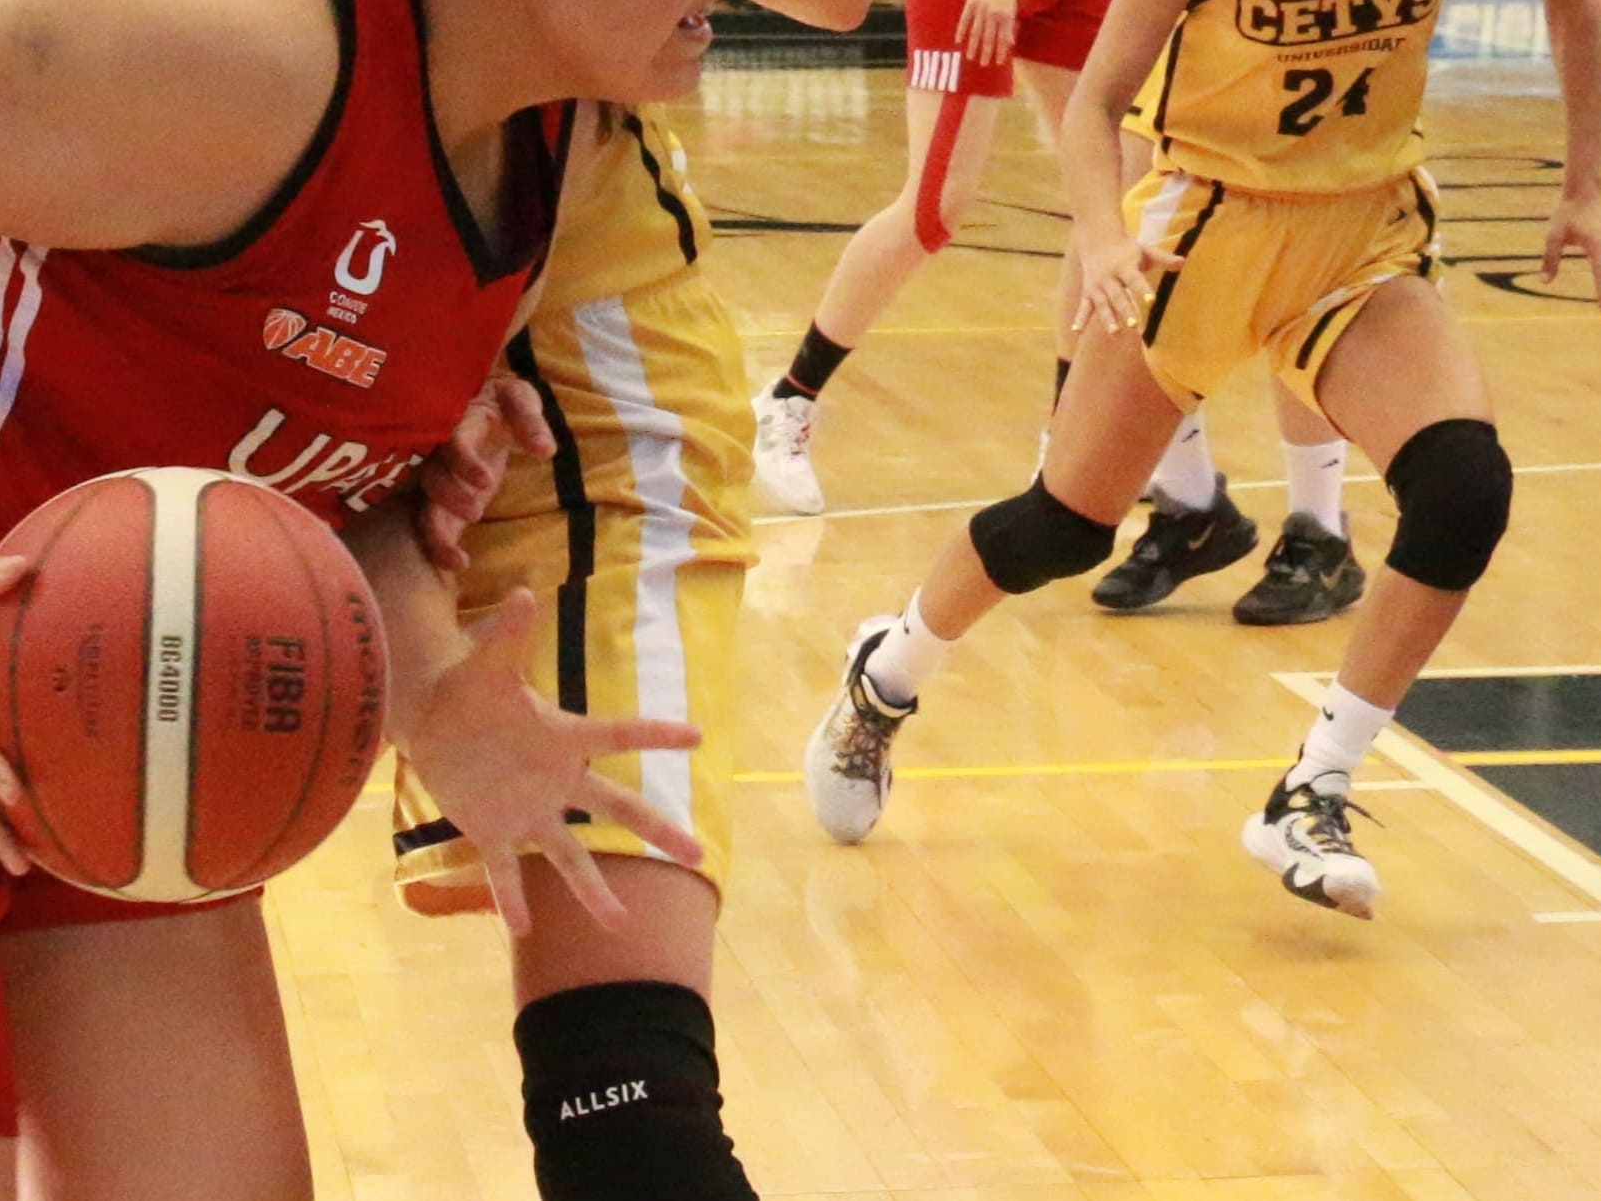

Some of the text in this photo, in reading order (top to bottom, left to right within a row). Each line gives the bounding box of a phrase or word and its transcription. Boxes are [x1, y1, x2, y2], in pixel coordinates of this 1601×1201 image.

[1276, 67, 1377, 137] 24
[282, 325, 388, 389] ABE
[156, 634, 184, 724] BG4000
[266, 635, 307, 733] FIBA
[560, 1079, 649, 1121] ALLSIX
